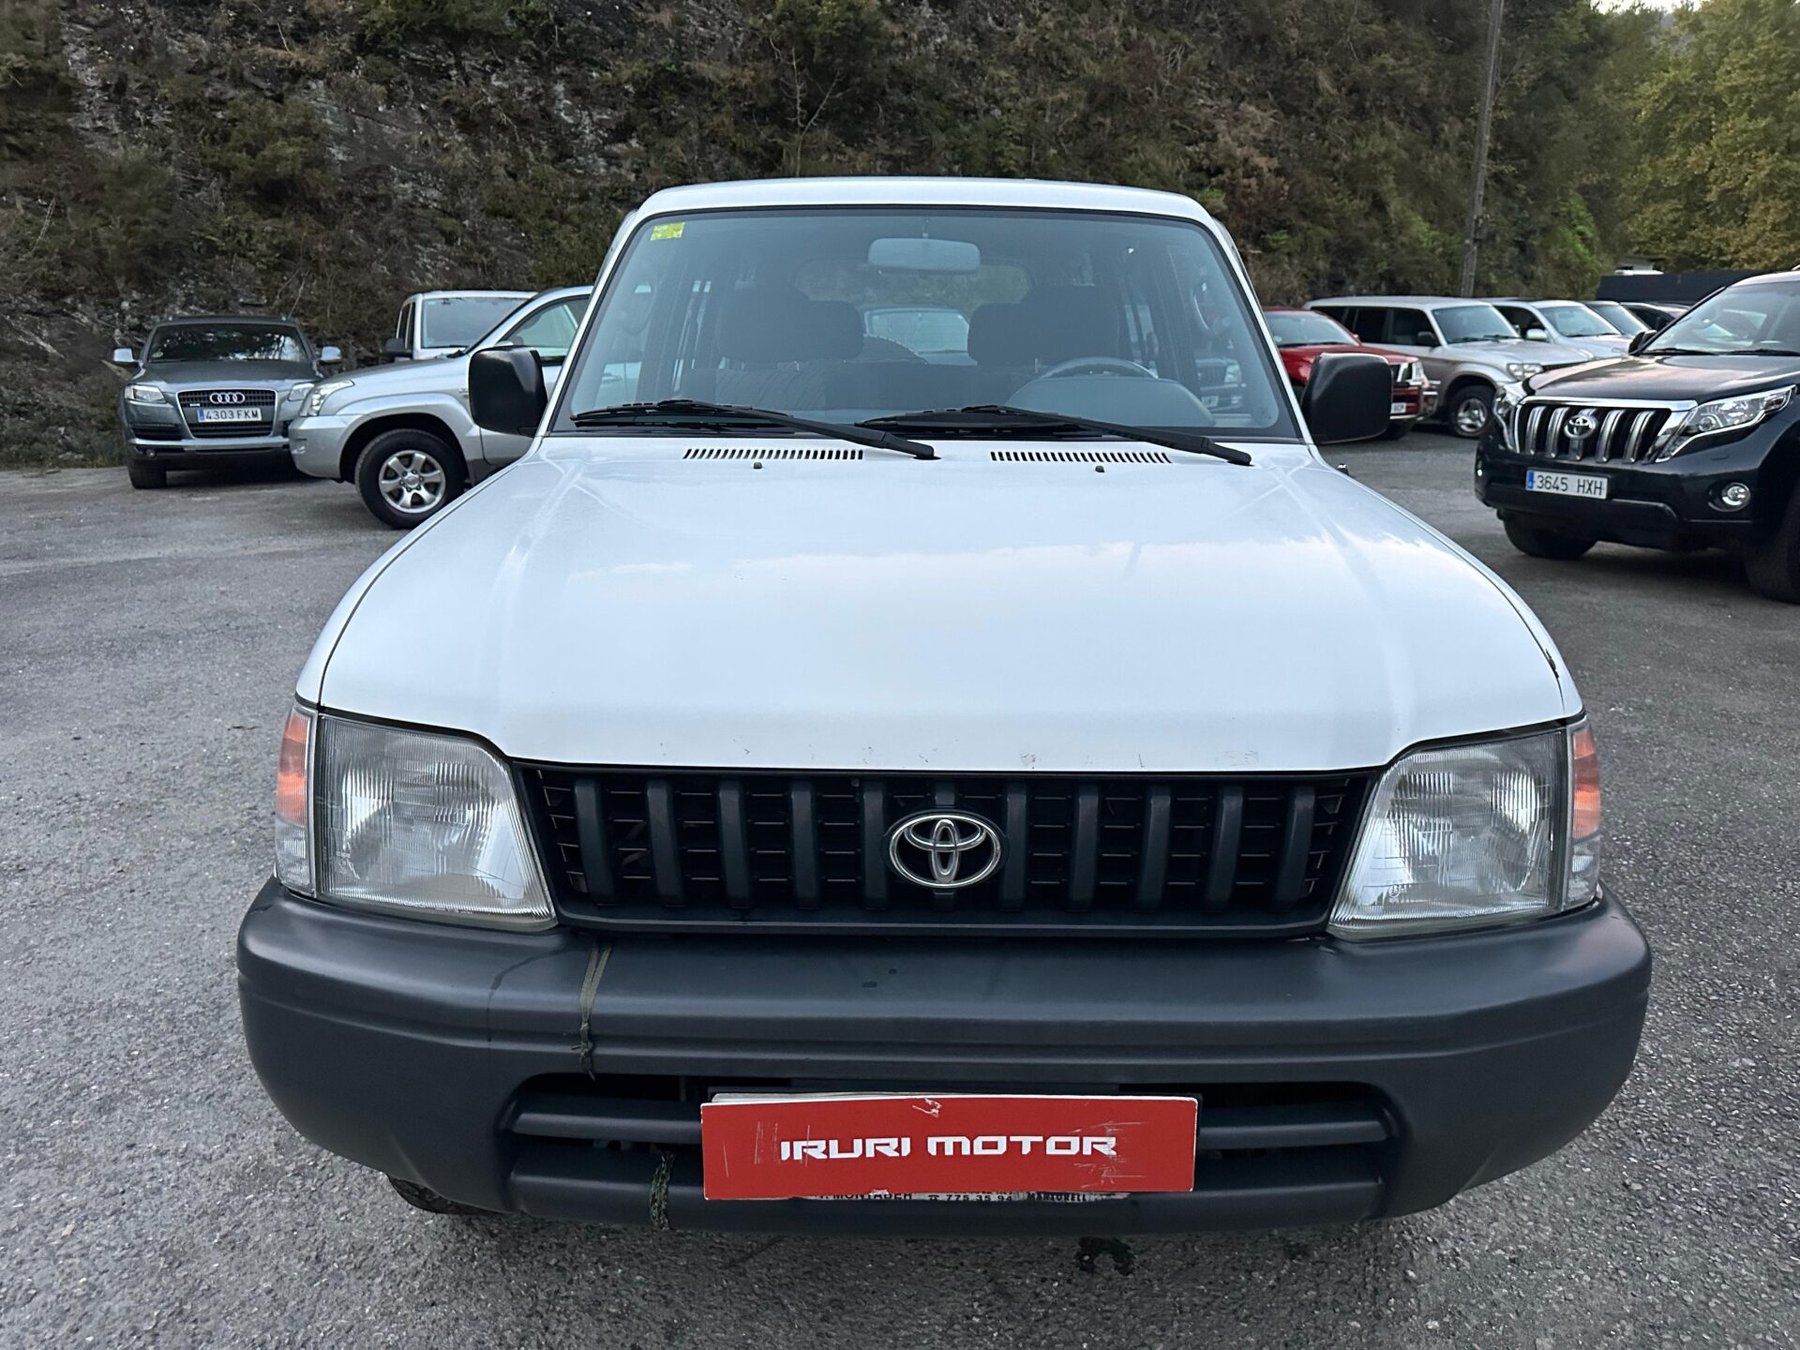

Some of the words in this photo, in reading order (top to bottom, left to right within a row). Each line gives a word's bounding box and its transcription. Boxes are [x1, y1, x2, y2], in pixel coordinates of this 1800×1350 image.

[206, 410, 235, 420] 4303
[1537, 474, 1568, 492] 3645
[1577, 478, 1603, 496] HXH
[780, 1137, 911, 1161] IRURI
[927, 1135, 1117, 1156] MOTOR
